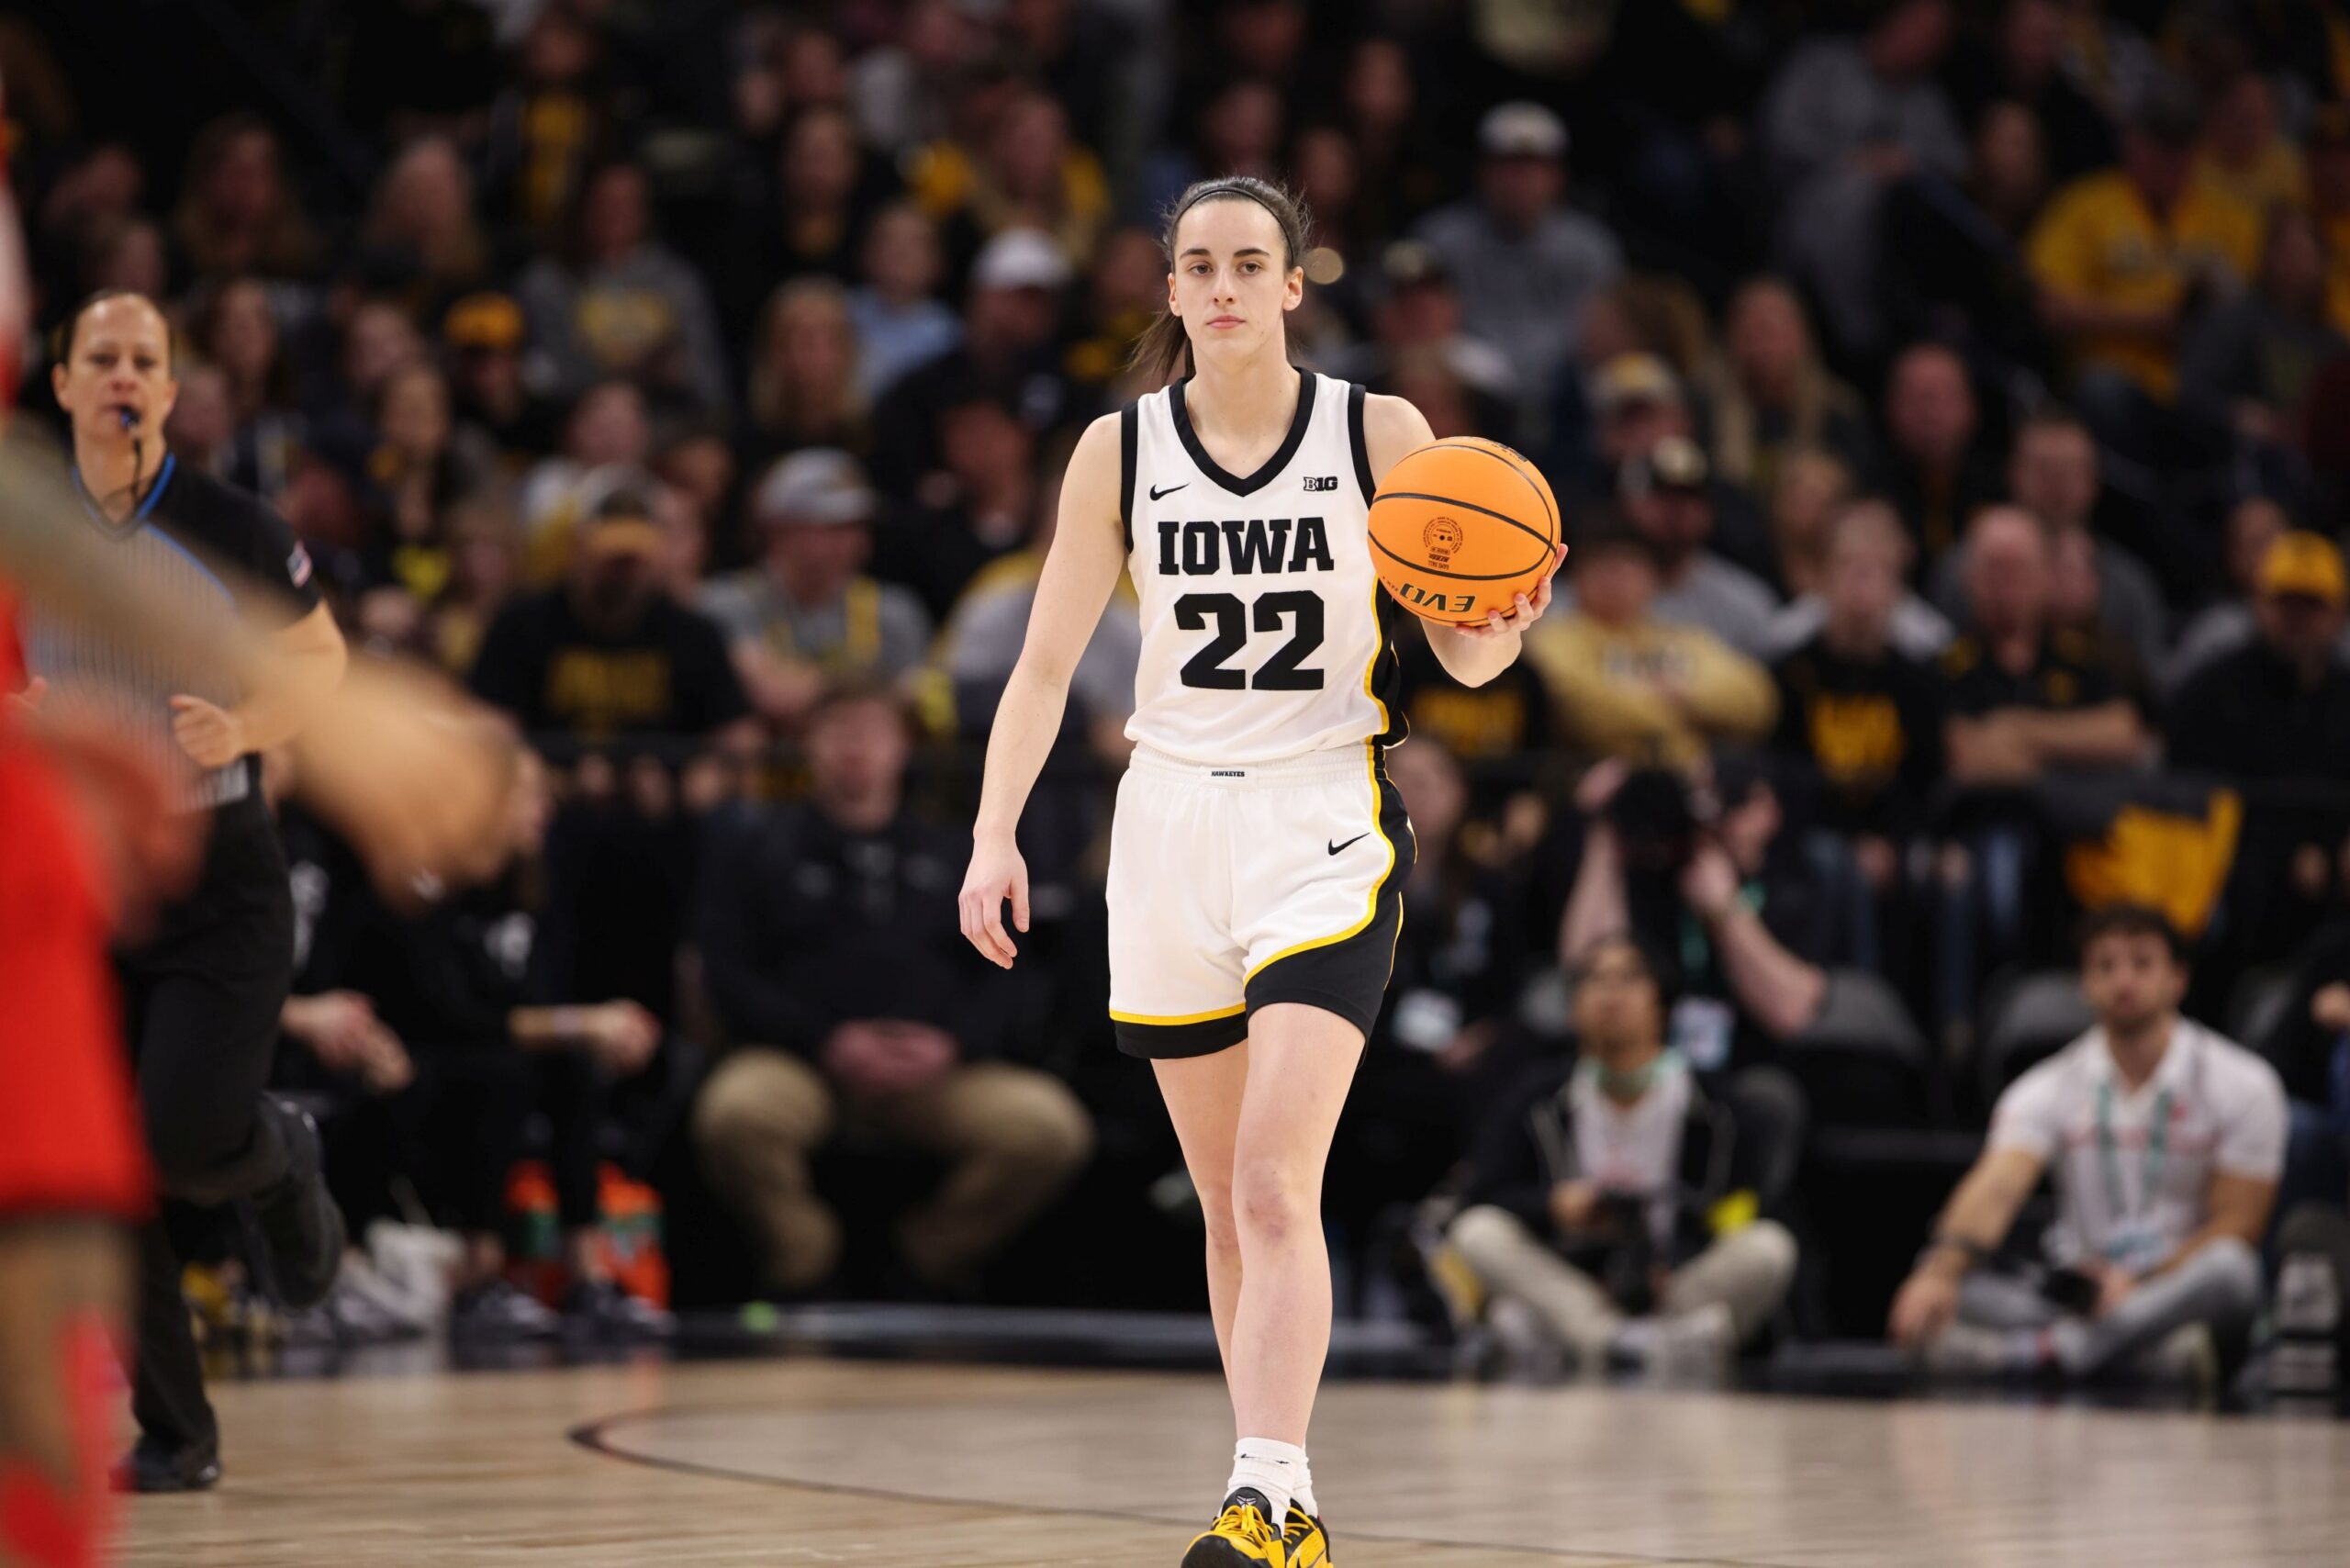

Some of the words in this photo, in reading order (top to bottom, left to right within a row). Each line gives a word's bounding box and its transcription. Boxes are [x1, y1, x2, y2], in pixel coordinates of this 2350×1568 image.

[1158, 517, 1334, 576] IOWA
[1399, 583, 1476, 612] EVO
[1173, 590, 1325, 690] 22
